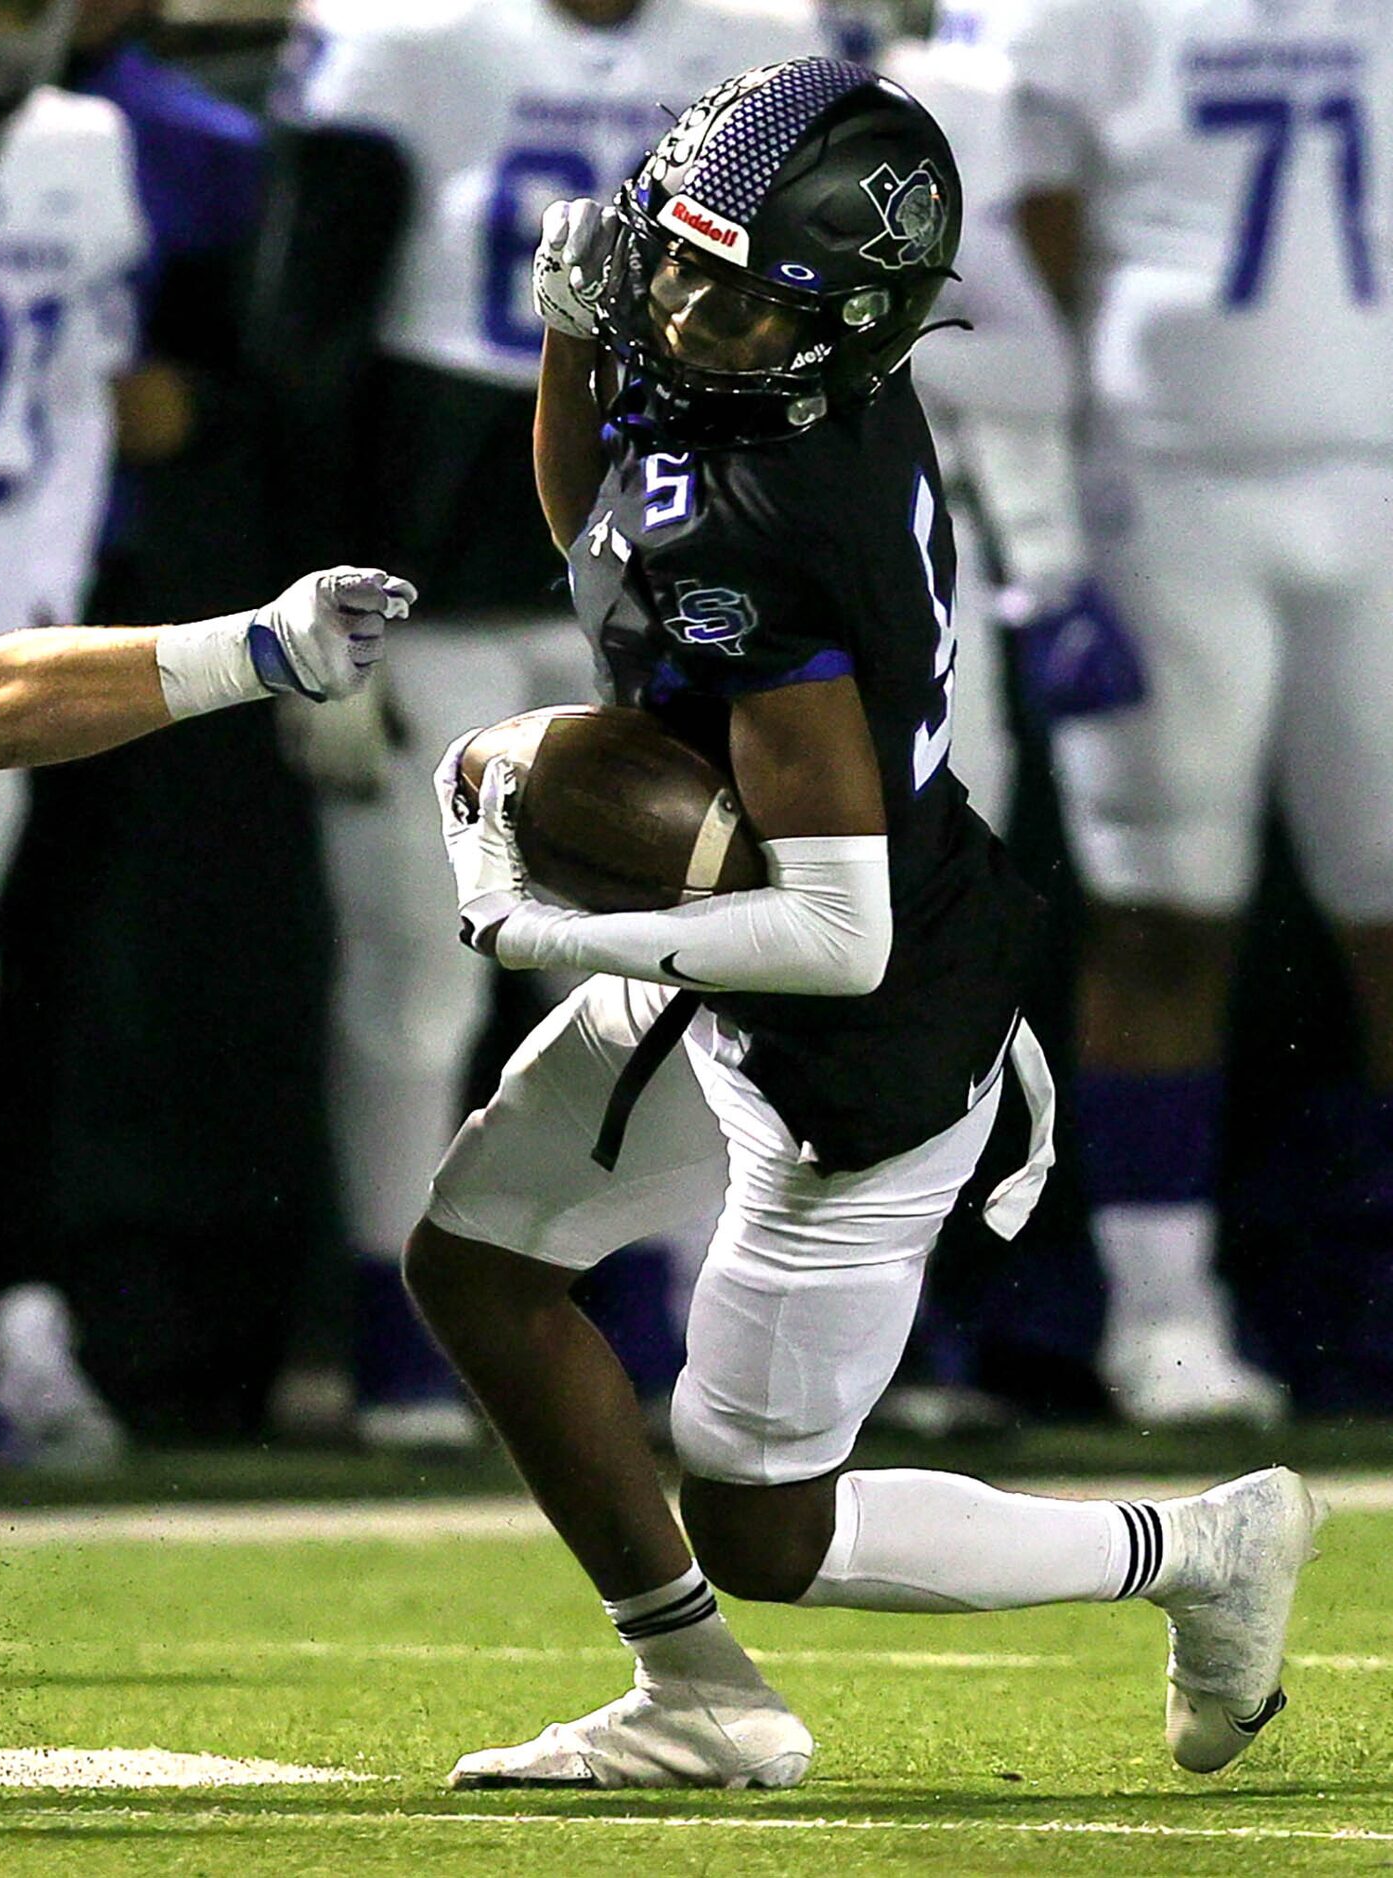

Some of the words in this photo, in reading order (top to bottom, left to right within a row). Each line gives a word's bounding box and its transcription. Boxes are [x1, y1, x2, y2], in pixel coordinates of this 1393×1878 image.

[672, 201, 739, 248] Riddell
[1193, 97, 1378, 308] 71
[640, 451, 697, 533] 5
